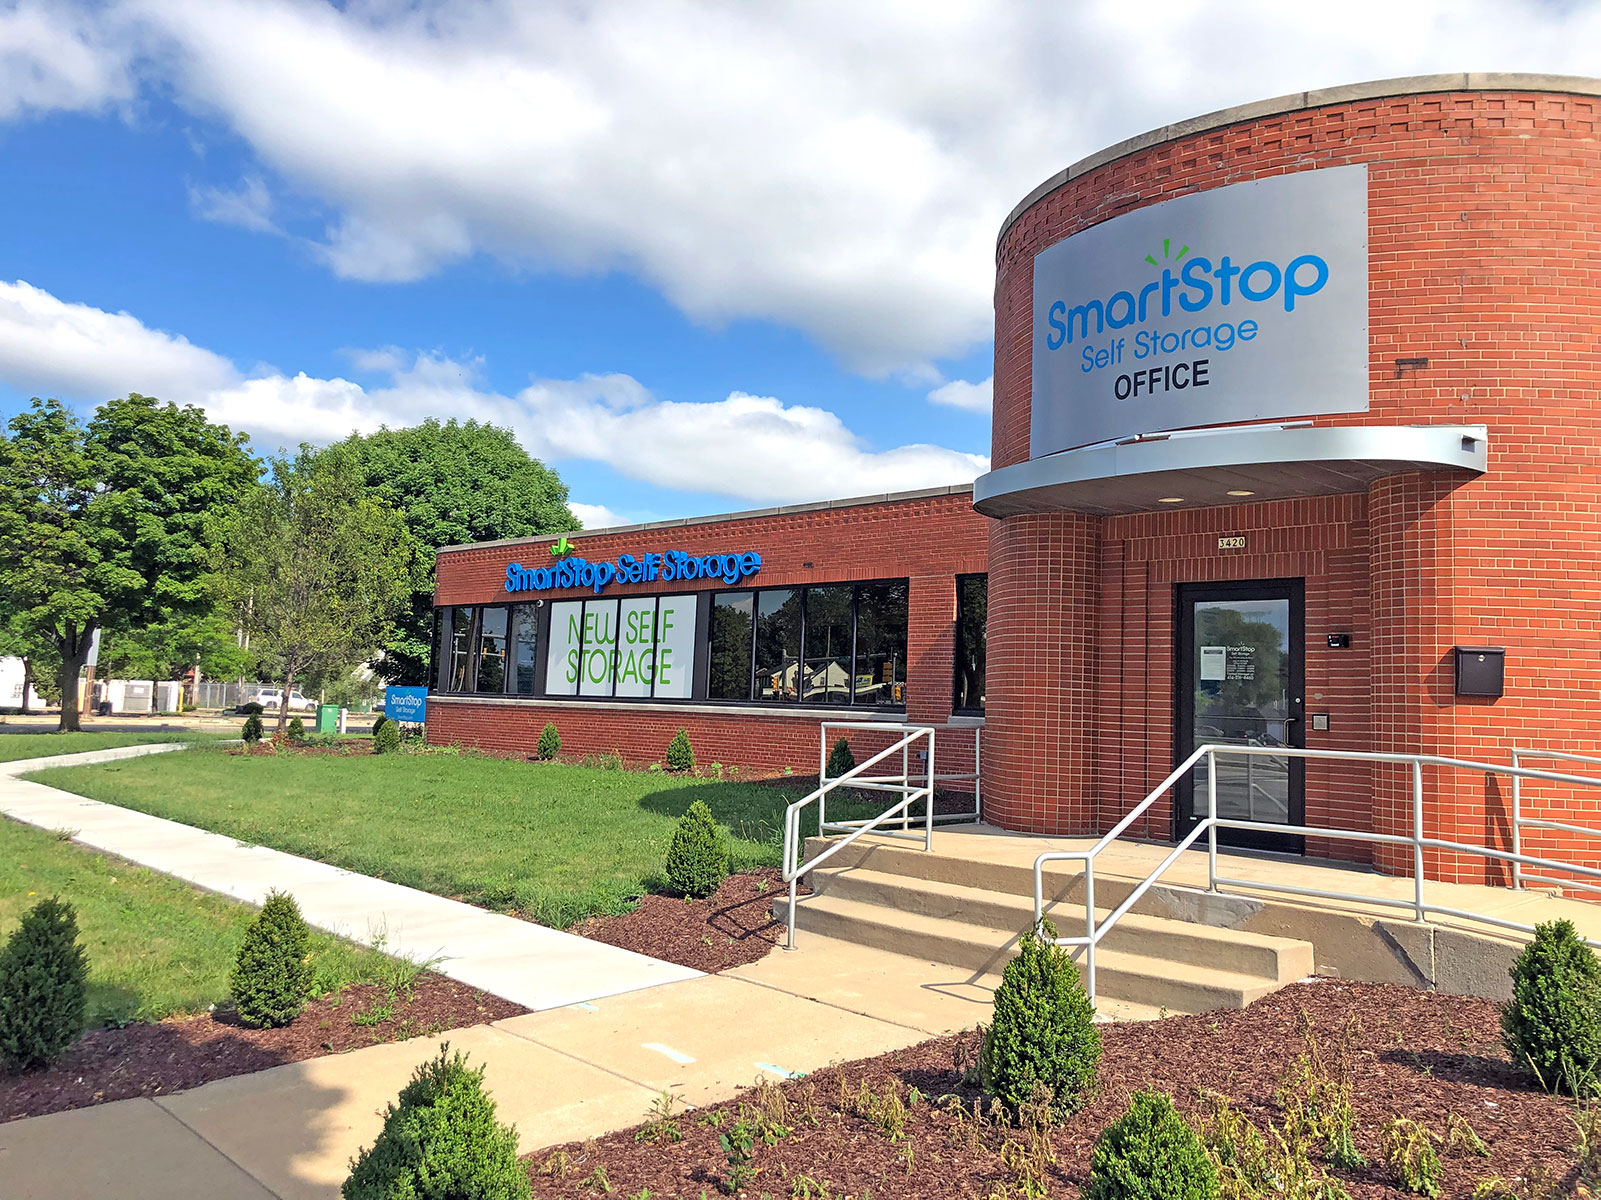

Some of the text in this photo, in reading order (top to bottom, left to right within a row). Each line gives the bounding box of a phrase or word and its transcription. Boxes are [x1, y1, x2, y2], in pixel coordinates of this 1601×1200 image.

[1047, 254, 1329, 351] SmartStop
[1081, 319, 1259, 373] Self Storage
[1114, 359, 1210, 401] OFFICE
[1219, 537, 1244, 548] 3420
[505, 550, 761, 593] SmartStop Self Storage
[568, 609, 675, 645] NEW SELF
[566, 648, 673, 685] STORAGE
[391, 694, 422, 708] SmartStop
